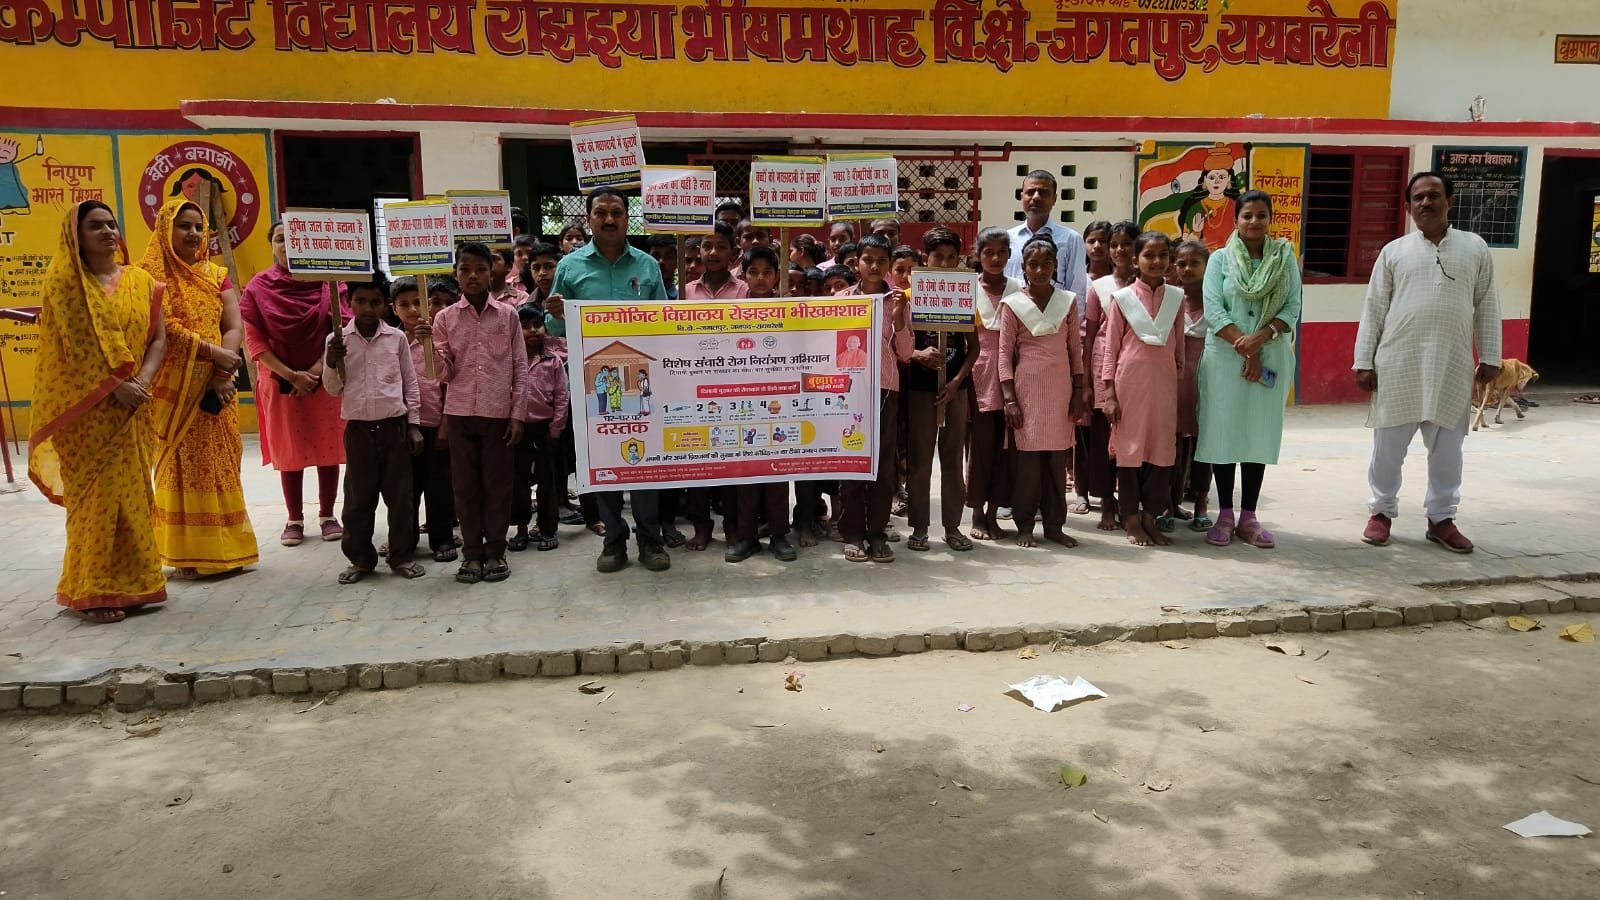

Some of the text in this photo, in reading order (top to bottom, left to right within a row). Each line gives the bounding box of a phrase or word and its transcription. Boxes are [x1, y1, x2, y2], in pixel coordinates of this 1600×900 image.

[265, 0, 475, 54] विद्यालय
[145, 147, 237, 181] बेटी बचाओ
[1450, 152, 1512, 166] आज का विद्यालय
[42, 156, 96, 186] निपुण
[693, 177, 698, 190] है
[1255, 169, 1300, 189] तेरा वैभव
[32, 187, 65, 206] भारत
[771, 188, 777, 201] से
[780, 188, 797, 201] उनको
[308, 221, 322, 232] जल
[324, 218, 334, 232] को
[356, 219, 364, 233] है
[303, 235, 310, 250] से
[312, 236, 332, 250] सबको
[334, 239, 355, 251] बचाना
[585, 303, 869, 324] कम्पोजिट विद्यालय रोझइया भीखमशाह
[662, 353, 830, 368] विशेष संचारी रोग नियंत्रण अभियान
[663, 398, 831, 413] 1 2 3 4 5 6
[596, 421, 650, 435] दस्तक
